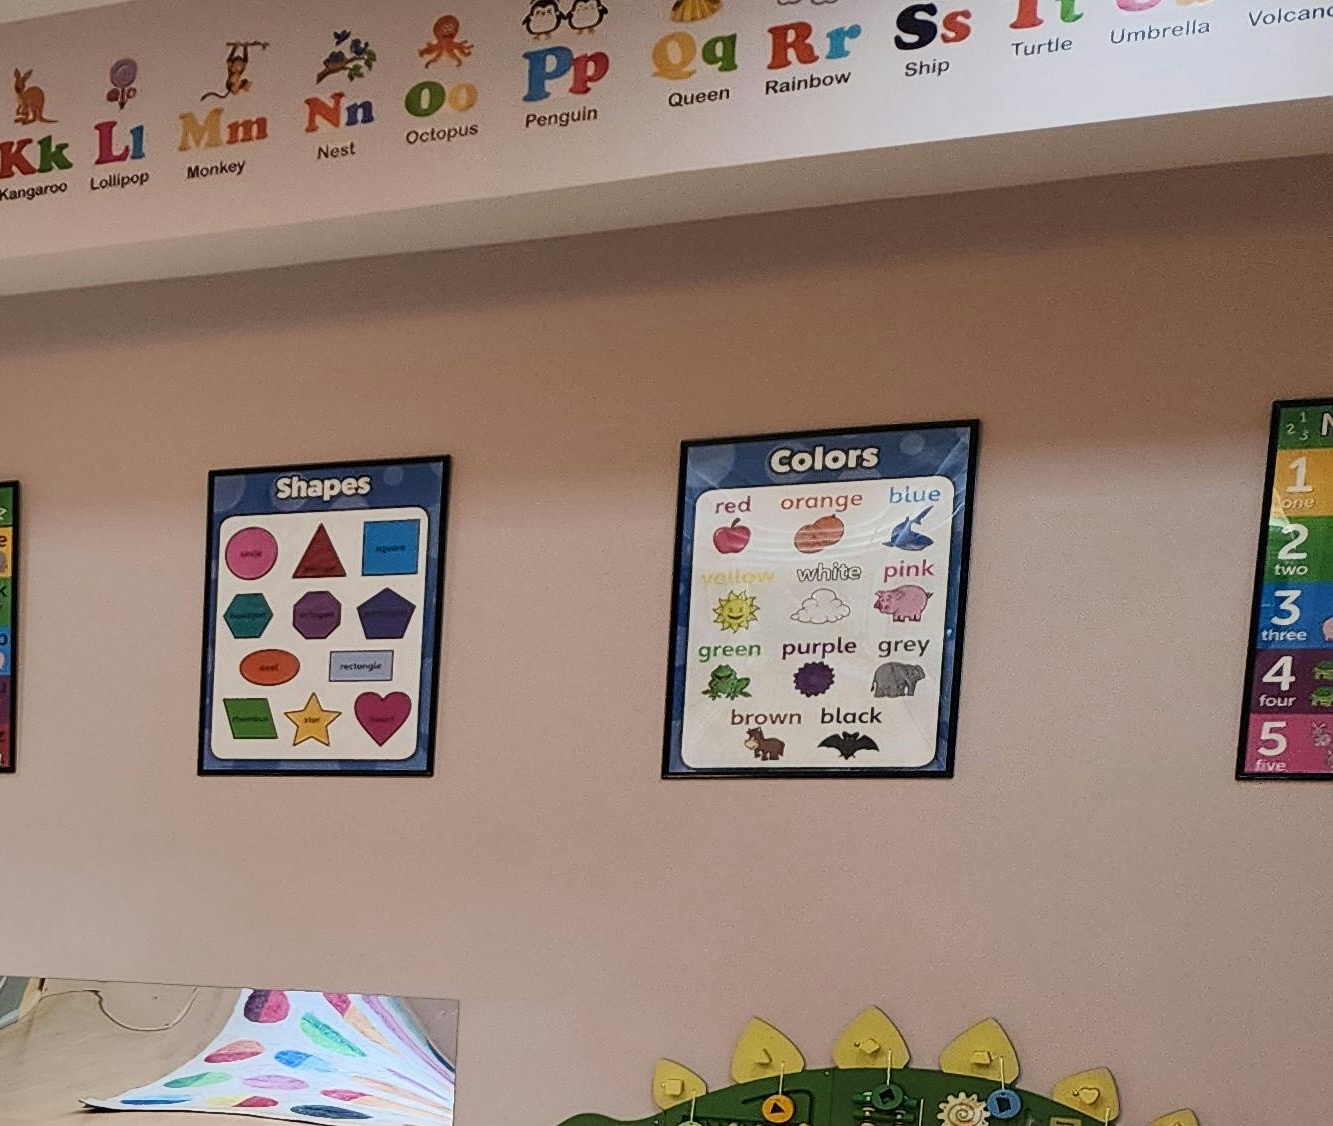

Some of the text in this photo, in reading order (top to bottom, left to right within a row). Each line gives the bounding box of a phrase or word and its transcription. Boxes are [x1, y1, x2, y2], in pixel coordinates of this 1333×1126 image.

[93, 119, 147, 166] Ll
[177, 107, 269, 152] Mm
[303, 92, 375, 133] Nn
[404, 80, 479, 118] Oo
[521, 45, 610, 103] Pp
[651, 31, 739, 81] Qq
[766, 21, 862, 70] Rr
[894, 3, 972, 51] Ss
[89, 169, 150, 192] Lollipop
[185, 159, 247, 180] Monkey
[317, 141, 356, 161] Nest
[405, 122, 479, 146] Octopus
[524, 105, 599, 129] Penguin
[667, 86, 731, 109] Queen
[765, 69, 852, 96] Rainbow
[904, 58, 950, 78] Ship
[1011, 37, 1073, 57] Turtle
[1110, 18, 1211, 45] Umbrella
[769, 445, 880, 474] Colors
[1285, 457, 1314, 494] 1
[276, 474, 372, 500] Shapes
[889, 486, 941, 503] blue
[714, 495, 752, 514] red
[780, 493, 863, 512] orange
[1282, 498, 1316, 509] one
[1277, 523, 1309, 560] 2
[700, 566, 775, 587] yellow
[796, 562, 863, 581] white
[883, 560, 935, 583] pink
[1274, 563, 1308, 576] two
[1271, 588, 1302, 626] 3
[1261, 629, 1308, 642] three
[698, 641, 762, 663] green
[782, 637, 857, 659] purple
[877, 637, 931, 658] grey
[340, 661, 382, 672] rectangle
[1262, 656, 1296, 691] 4
[1259, 695, 1296, 707] four
[730, 709, 802, 726] brown
[820, 707, 883, 724] black
[1257, 721, 1287, 756] 5
[1254, 760, 1286, 772] five
